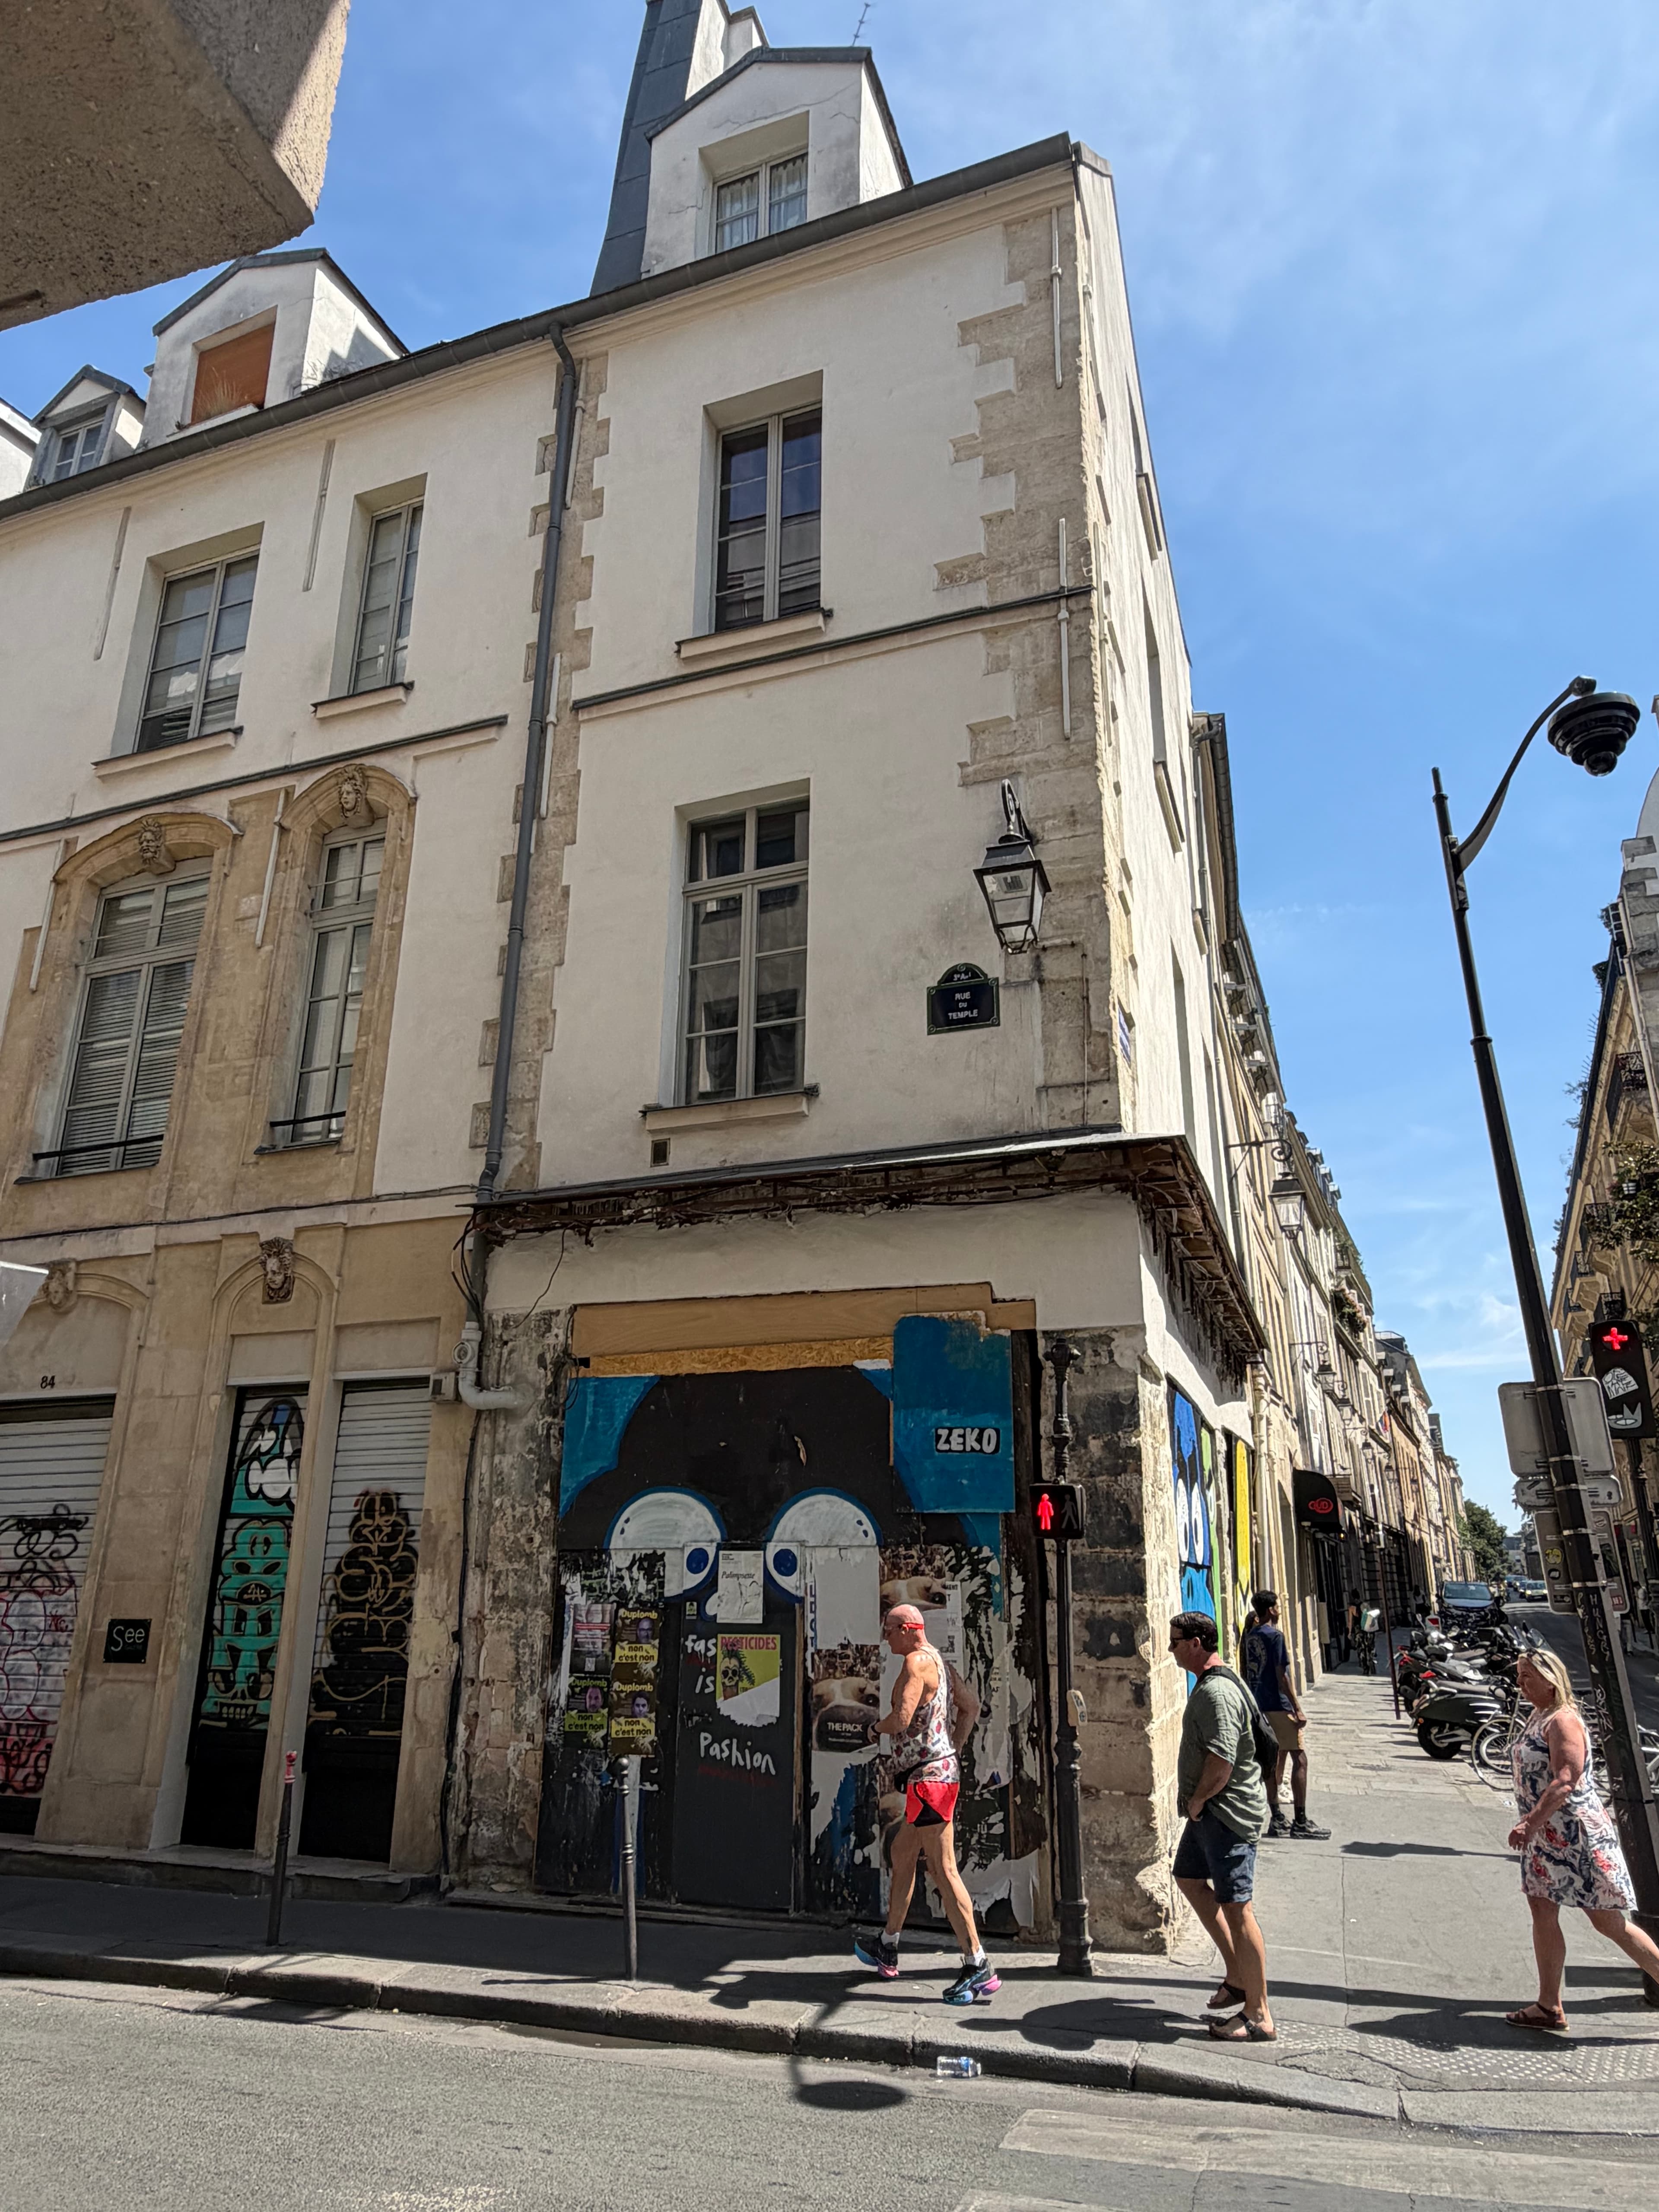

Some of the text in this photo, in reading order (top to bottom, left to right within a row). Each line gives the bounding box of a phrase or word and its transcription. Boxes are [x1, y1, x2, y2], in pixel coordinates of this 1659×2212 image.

[955, 992, 970, 1000] RUE
[948, 1009, 979, 1020] TEMPLE
[40, 1375, 56, 1389] 84
[937, 1427, 997, 1453] ZEKO
[621, 1610, 658, 1619] Duplomb
[111, 1626, 145, 1652] See
[720, 1637, 777, 1650] PESTICIDES
[618, 1653, 638, 1662] c'est
[695, 1667, 715, 1694] is
[617, 1683, 653, 1693] Duplomb
[568, 1722, 587, 1730] c'est
[826, 1722, 864, 1732] THE PACK
[615, 1727, 652, 1736] c'est non
[699, 1732, 776, 1776] Pashion
